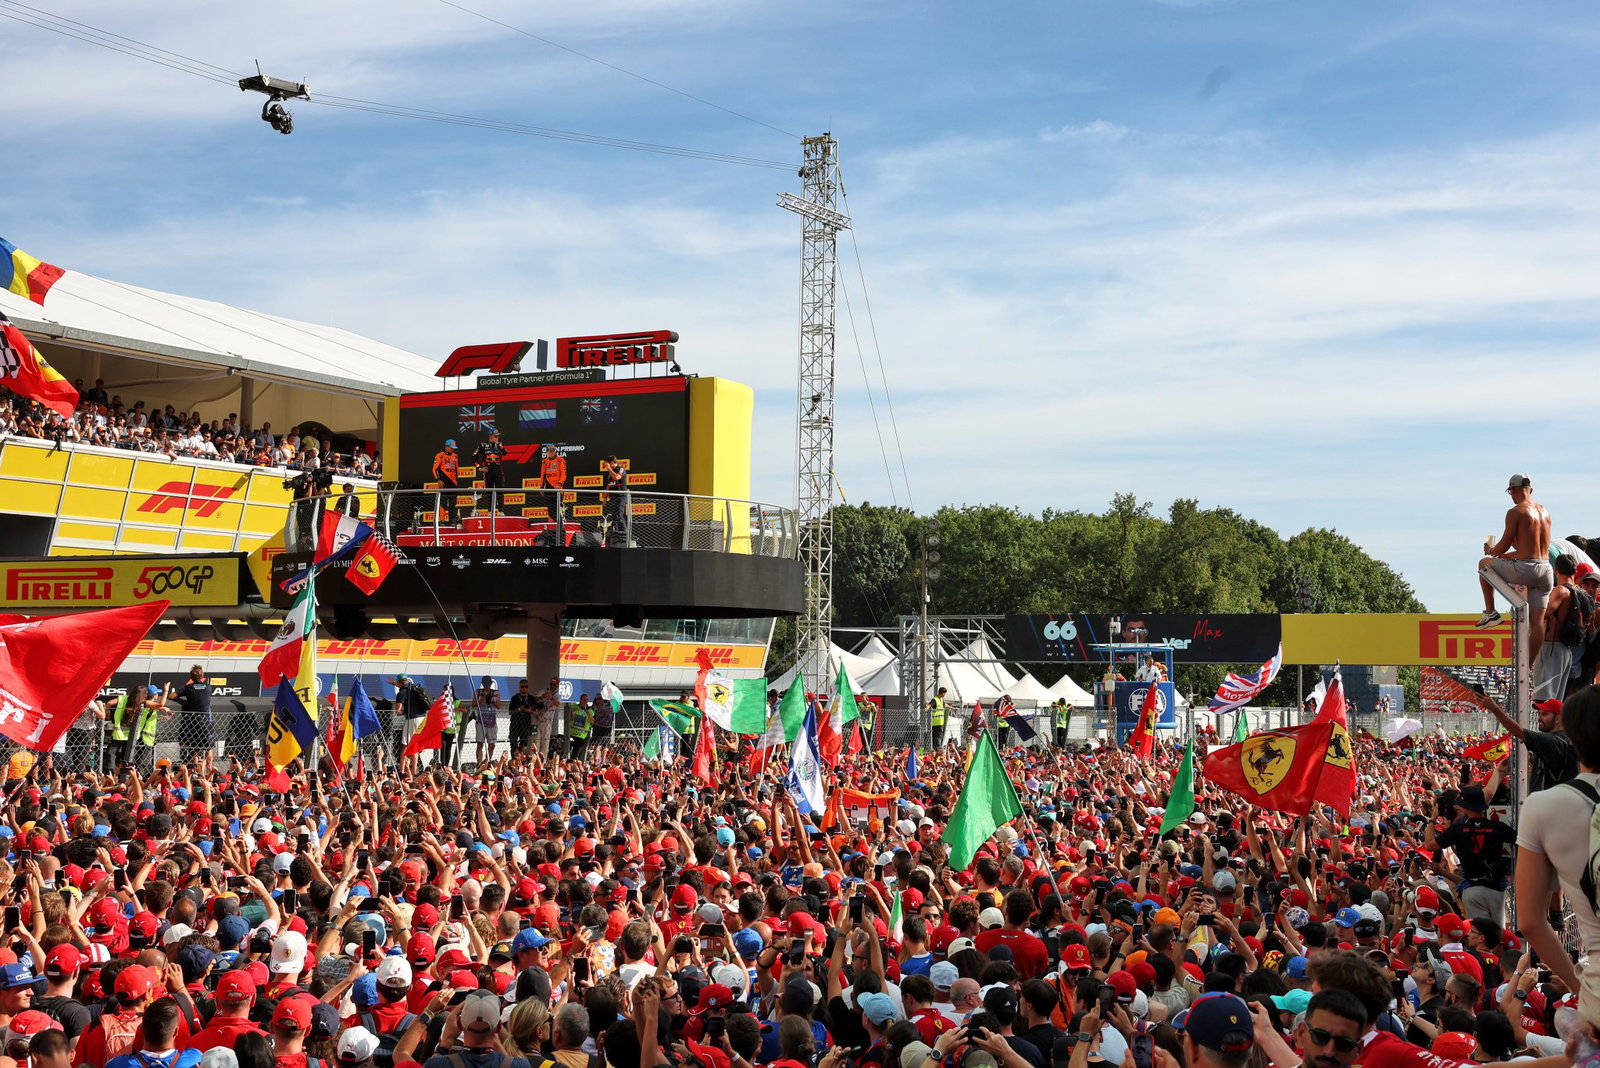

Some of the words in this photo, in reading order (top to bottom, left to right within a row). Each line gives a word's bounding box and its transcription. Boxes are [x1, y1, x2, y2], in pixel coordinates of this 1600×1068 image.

[556, 329, 680, 368] PIRELLI
[479, 377, 501, 387] Global
[502, 375, 518, 385] Tyre
[519, 373, 545, 384] Partner
[546, 372, 554, 381] of
[555, 371, 584, 381] Formula
[477, 520, 483, 529] 1
[531, 557, 549, 565] MSC
[6, 567, 114, 601] PIRELLI
[1043, 620, 1078, 641] 66
[1193, 618, 1224, 641] Max
[432, 638, 489, 659] DHL
[615, 644, 661, 663] DHL
[211, 687, 242, 696] APS
